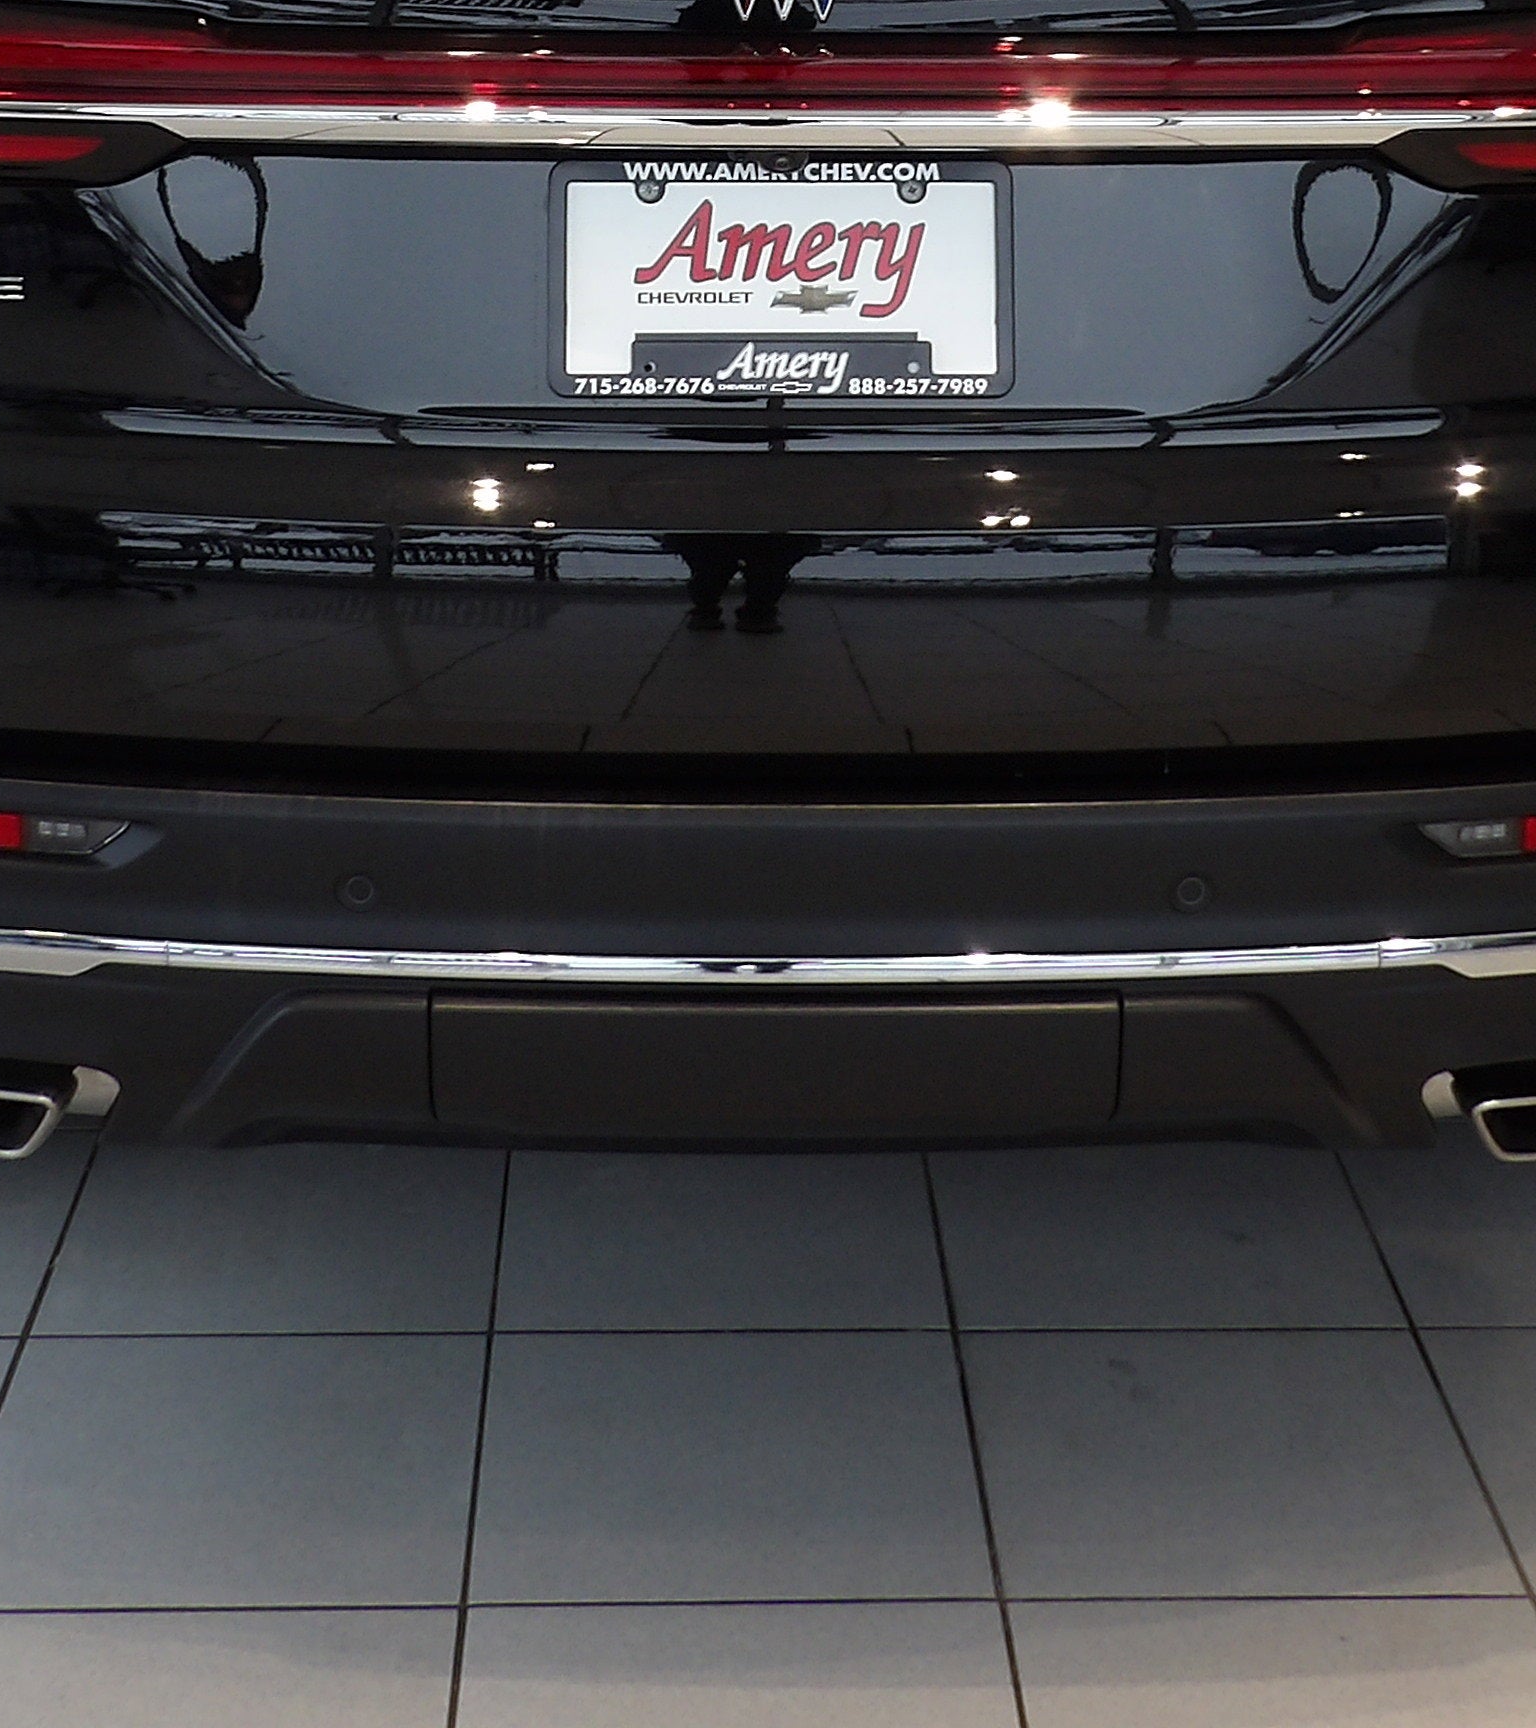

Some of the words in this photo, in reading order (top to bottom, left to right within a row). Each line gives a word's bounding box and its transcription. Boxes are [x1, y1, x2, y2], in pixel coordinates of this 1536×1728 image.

[633, 199, 926, 318] Amery
[637, 291, 754, 305] CHEVROLET
[716, 341, 850, 394] Amery
[573, 377, 716, 395] 715-268-7676
[848, 377, 989, 396] 888-257-7989
